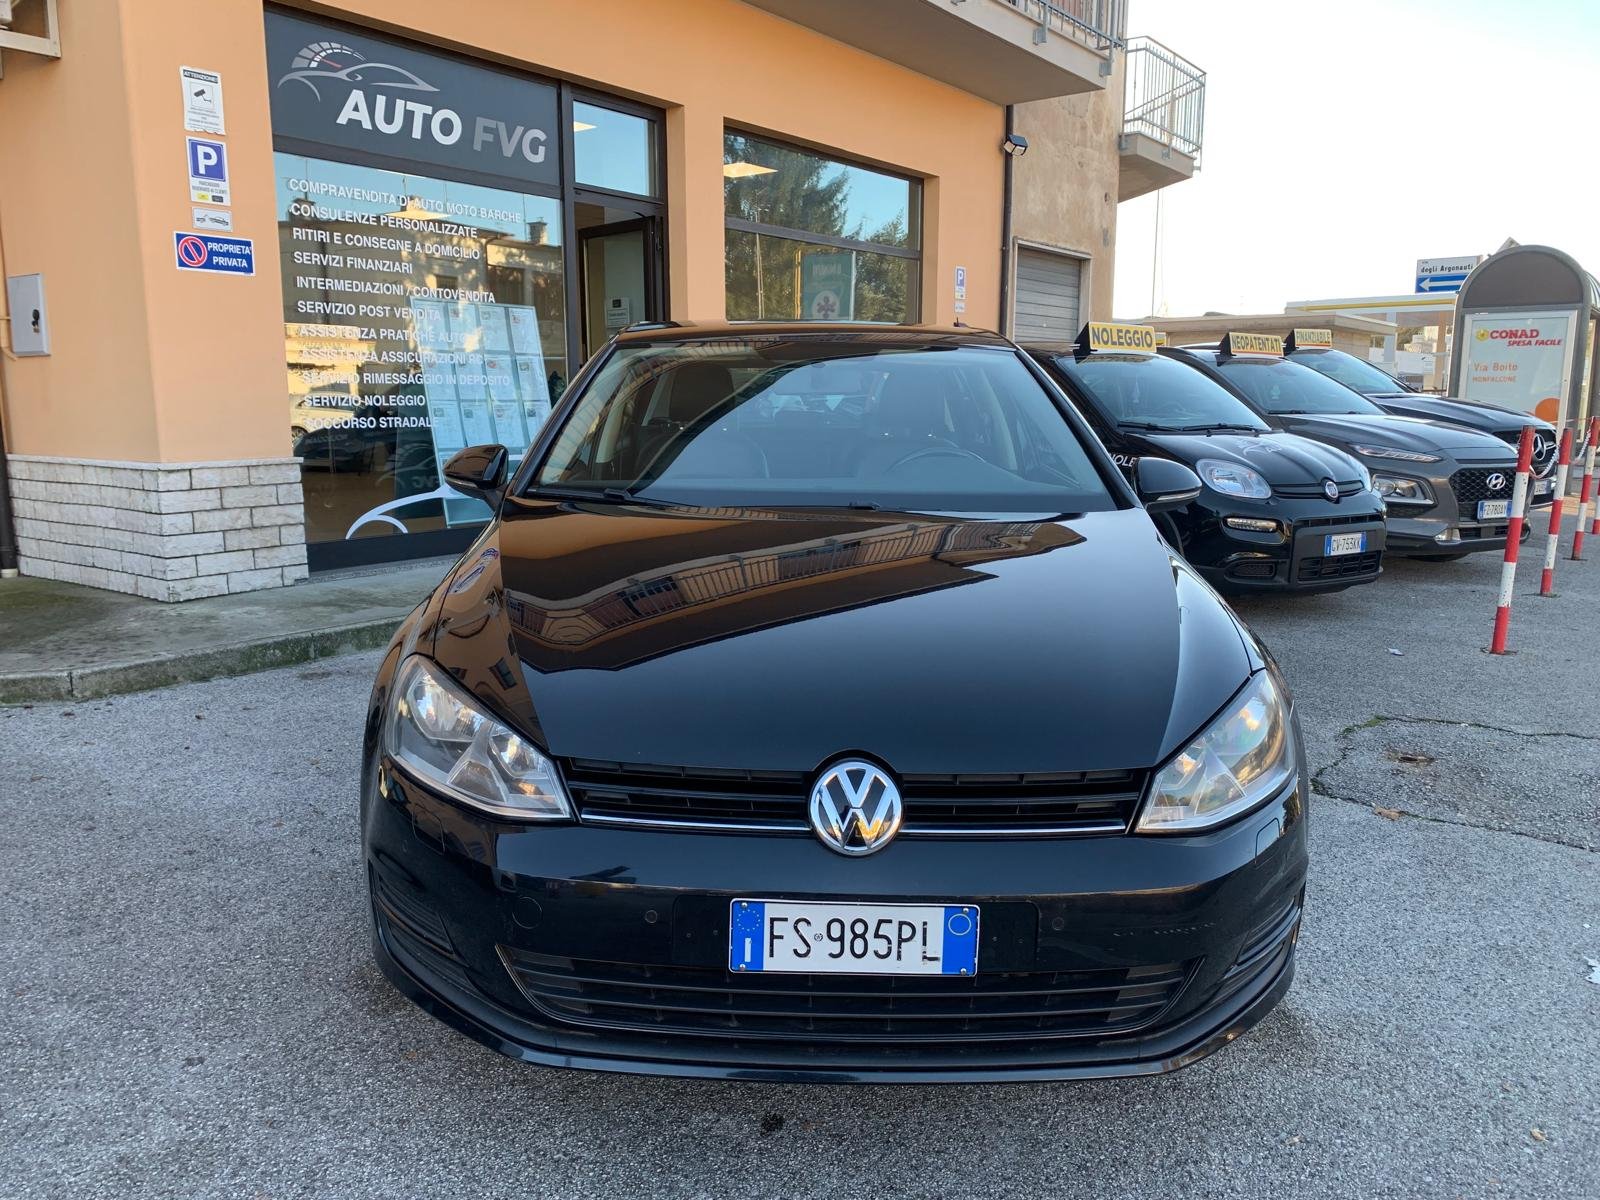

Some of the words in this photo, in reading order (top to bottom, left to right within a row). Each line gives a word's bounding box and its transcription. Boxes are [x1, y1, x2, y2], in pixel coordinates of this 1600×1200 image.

[336, 89, 463, 146] AUTO
[472, 116, 548, 164] FVG
[197, 145, 218, 175] P
[289, 178, 397, 205] COMPRAVENDITA
[399, 195, 410, 208] DI
[412, 198, 444, 213] AUTO
[446, 202, 479, 217] MOTO
[480, 207, 522, 223] BARCHE
[291, 203, 378, 226] CONSULENZE
[380, 216, 478, 239] PERSONALIZZATE
[292, 227, 331, 243] RITIRI
[333, 232, 342, 245] E
[345, 233, 412, 252] CONSEGNE
[414, 241, 422, 254] A
[425, 243, 480, 260] DOMICILIO
[212, 256, 248, 268] PRIVATA
[293, 251, 344, 268] SERVIZI
[347, 257, 413, 274] FINANZIARI
[1421, 265, 1438, 273] degli
[1440, 264, 1473, 272] Argonauti
[296, 275, 404, 296] INTERMEDIAZIONI
[412, 286, 496, 303] CONTOVENDITA
[297, 301, 356, 316] SERVIZIO
[359, 304, 391, 318] POST
[395, 307, 441, 321] VENDITA
[299, 326, 377, 339] ASSISTENZA
[380, 328, 436, 341] PRATICHE
[1091, 326, 1153, 348] NOLEGGIO
[1490, 329, 1539, 339] CONAD
[1231, 335, 1281, 352] NEOPATENTATI
[302, 349, 378, 361] ASSISTENZA
[380, 351, 466, 364] ASSICURAZIONI
[1474, 363, 1489, 372] Via
[1492, 362, 1518, 372] Boito
[303, 371, 360, 384] SERVIZIO
[363, 373, 443, 384] RIMESSAGGIO
[447, 374, 457, 385] IN
[460, 374, 510, 385] DEPOSITO
[303, 395, 363, 407] SERVIZIO
[365, 395, 426, 406] NOLEGGIO
[304, 417, 377, 429] SOCCORSO
[379, 417, 439, 428] STRADALE
